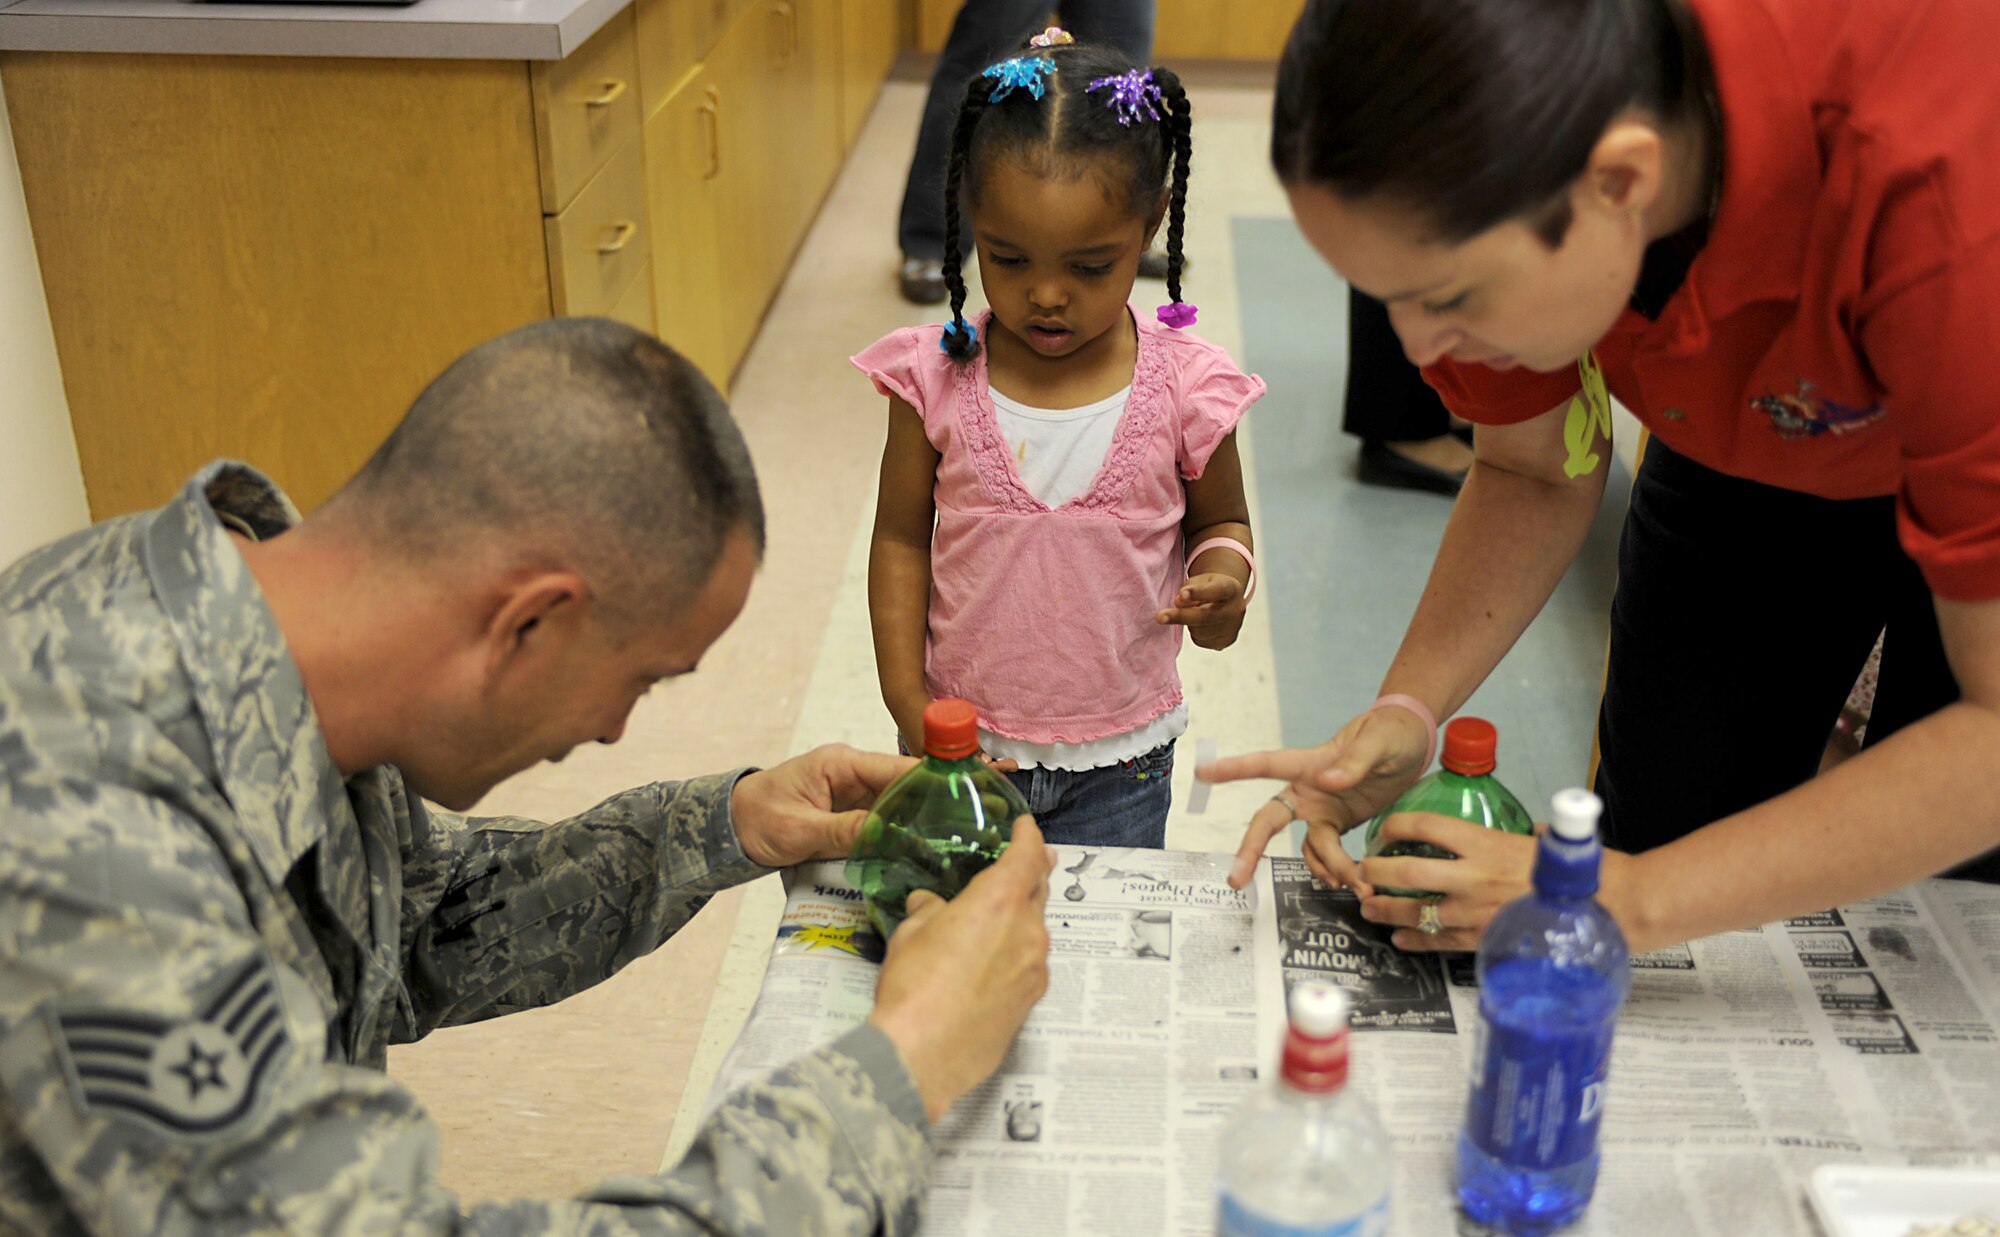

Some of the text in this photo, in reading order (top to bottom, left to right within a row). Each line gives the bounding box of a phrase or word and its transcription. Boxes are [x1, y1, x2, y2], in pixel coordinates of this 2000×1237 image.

[813, 885, 864, 901] Work
[1120, 883, 1247, 900] Baby Photos!
[1141, 895, 1249, 909] We can't resist
[1304, 931, 1350, 948] OUT
[1286, 949, 1367, 970] MOVIN'
[1653, 1033, 1695, 1045] offering
[1771, 1037, 1814, 1046] GOLF:
[1629, 1134, 1685, 1147] effective
[1715, 1135, 1767, 1147] Experts
[1771, 1136, 1863, 1153] CLUTTER:
[1059, 1153, 1080, 1164] for
[1083, 1153, 1142, 1165] medicine
